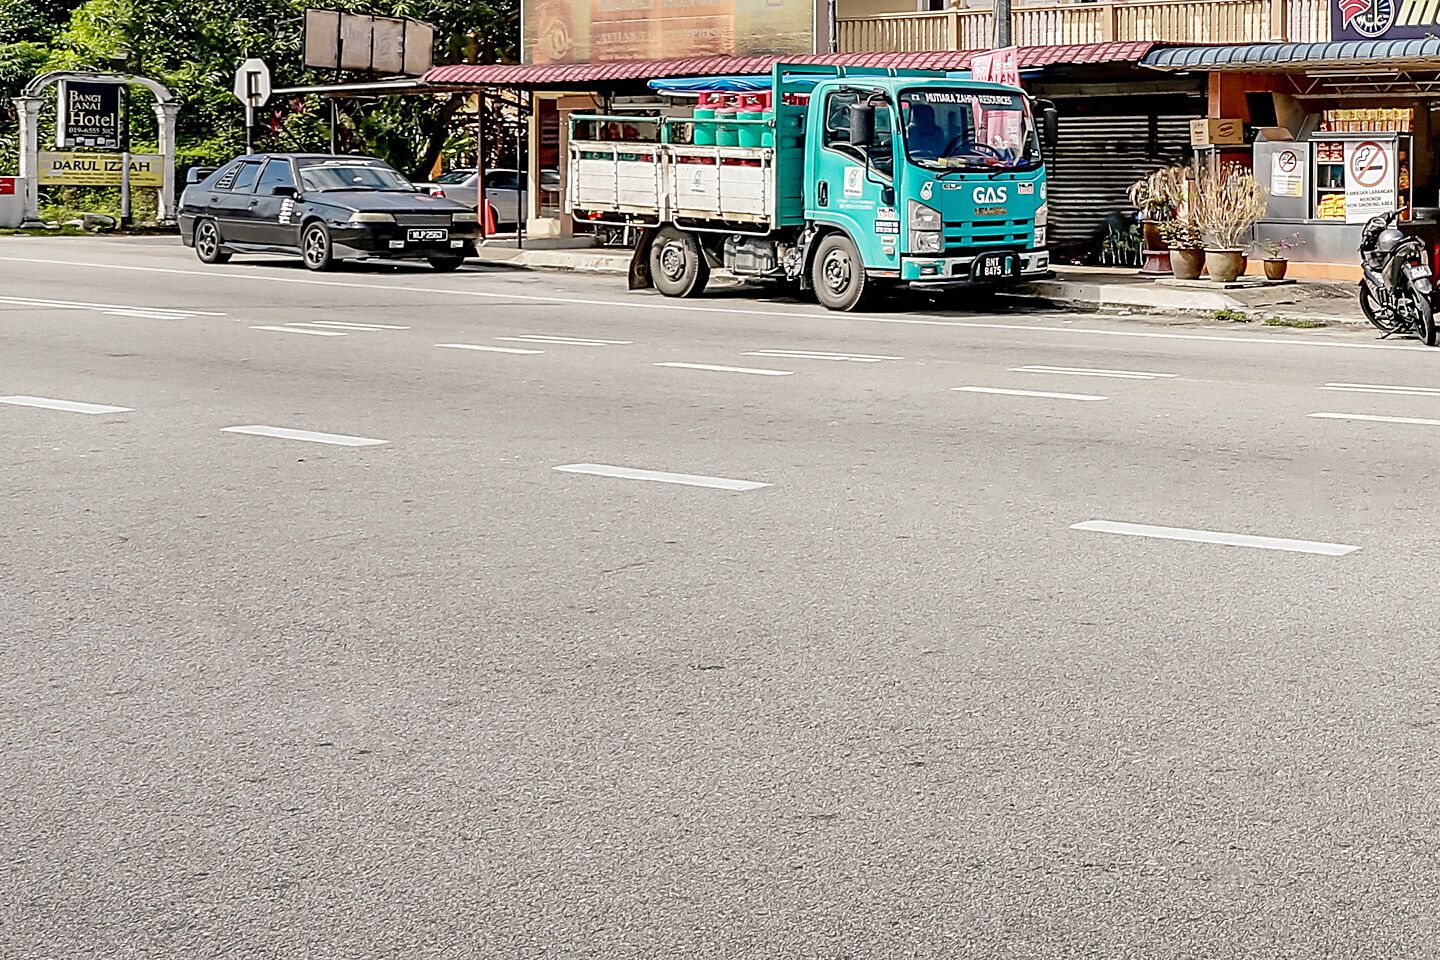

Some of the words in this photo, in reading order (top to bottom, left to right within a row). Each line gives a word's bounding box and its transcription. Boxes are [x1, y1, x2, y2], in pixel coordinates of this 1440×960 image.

[68, 111, 115, 126] Hotel
[53, 160, 100, 171] DARUL
[972, 187, 1008, 204] GAS
[985, 257, 1000, 267] BNT
